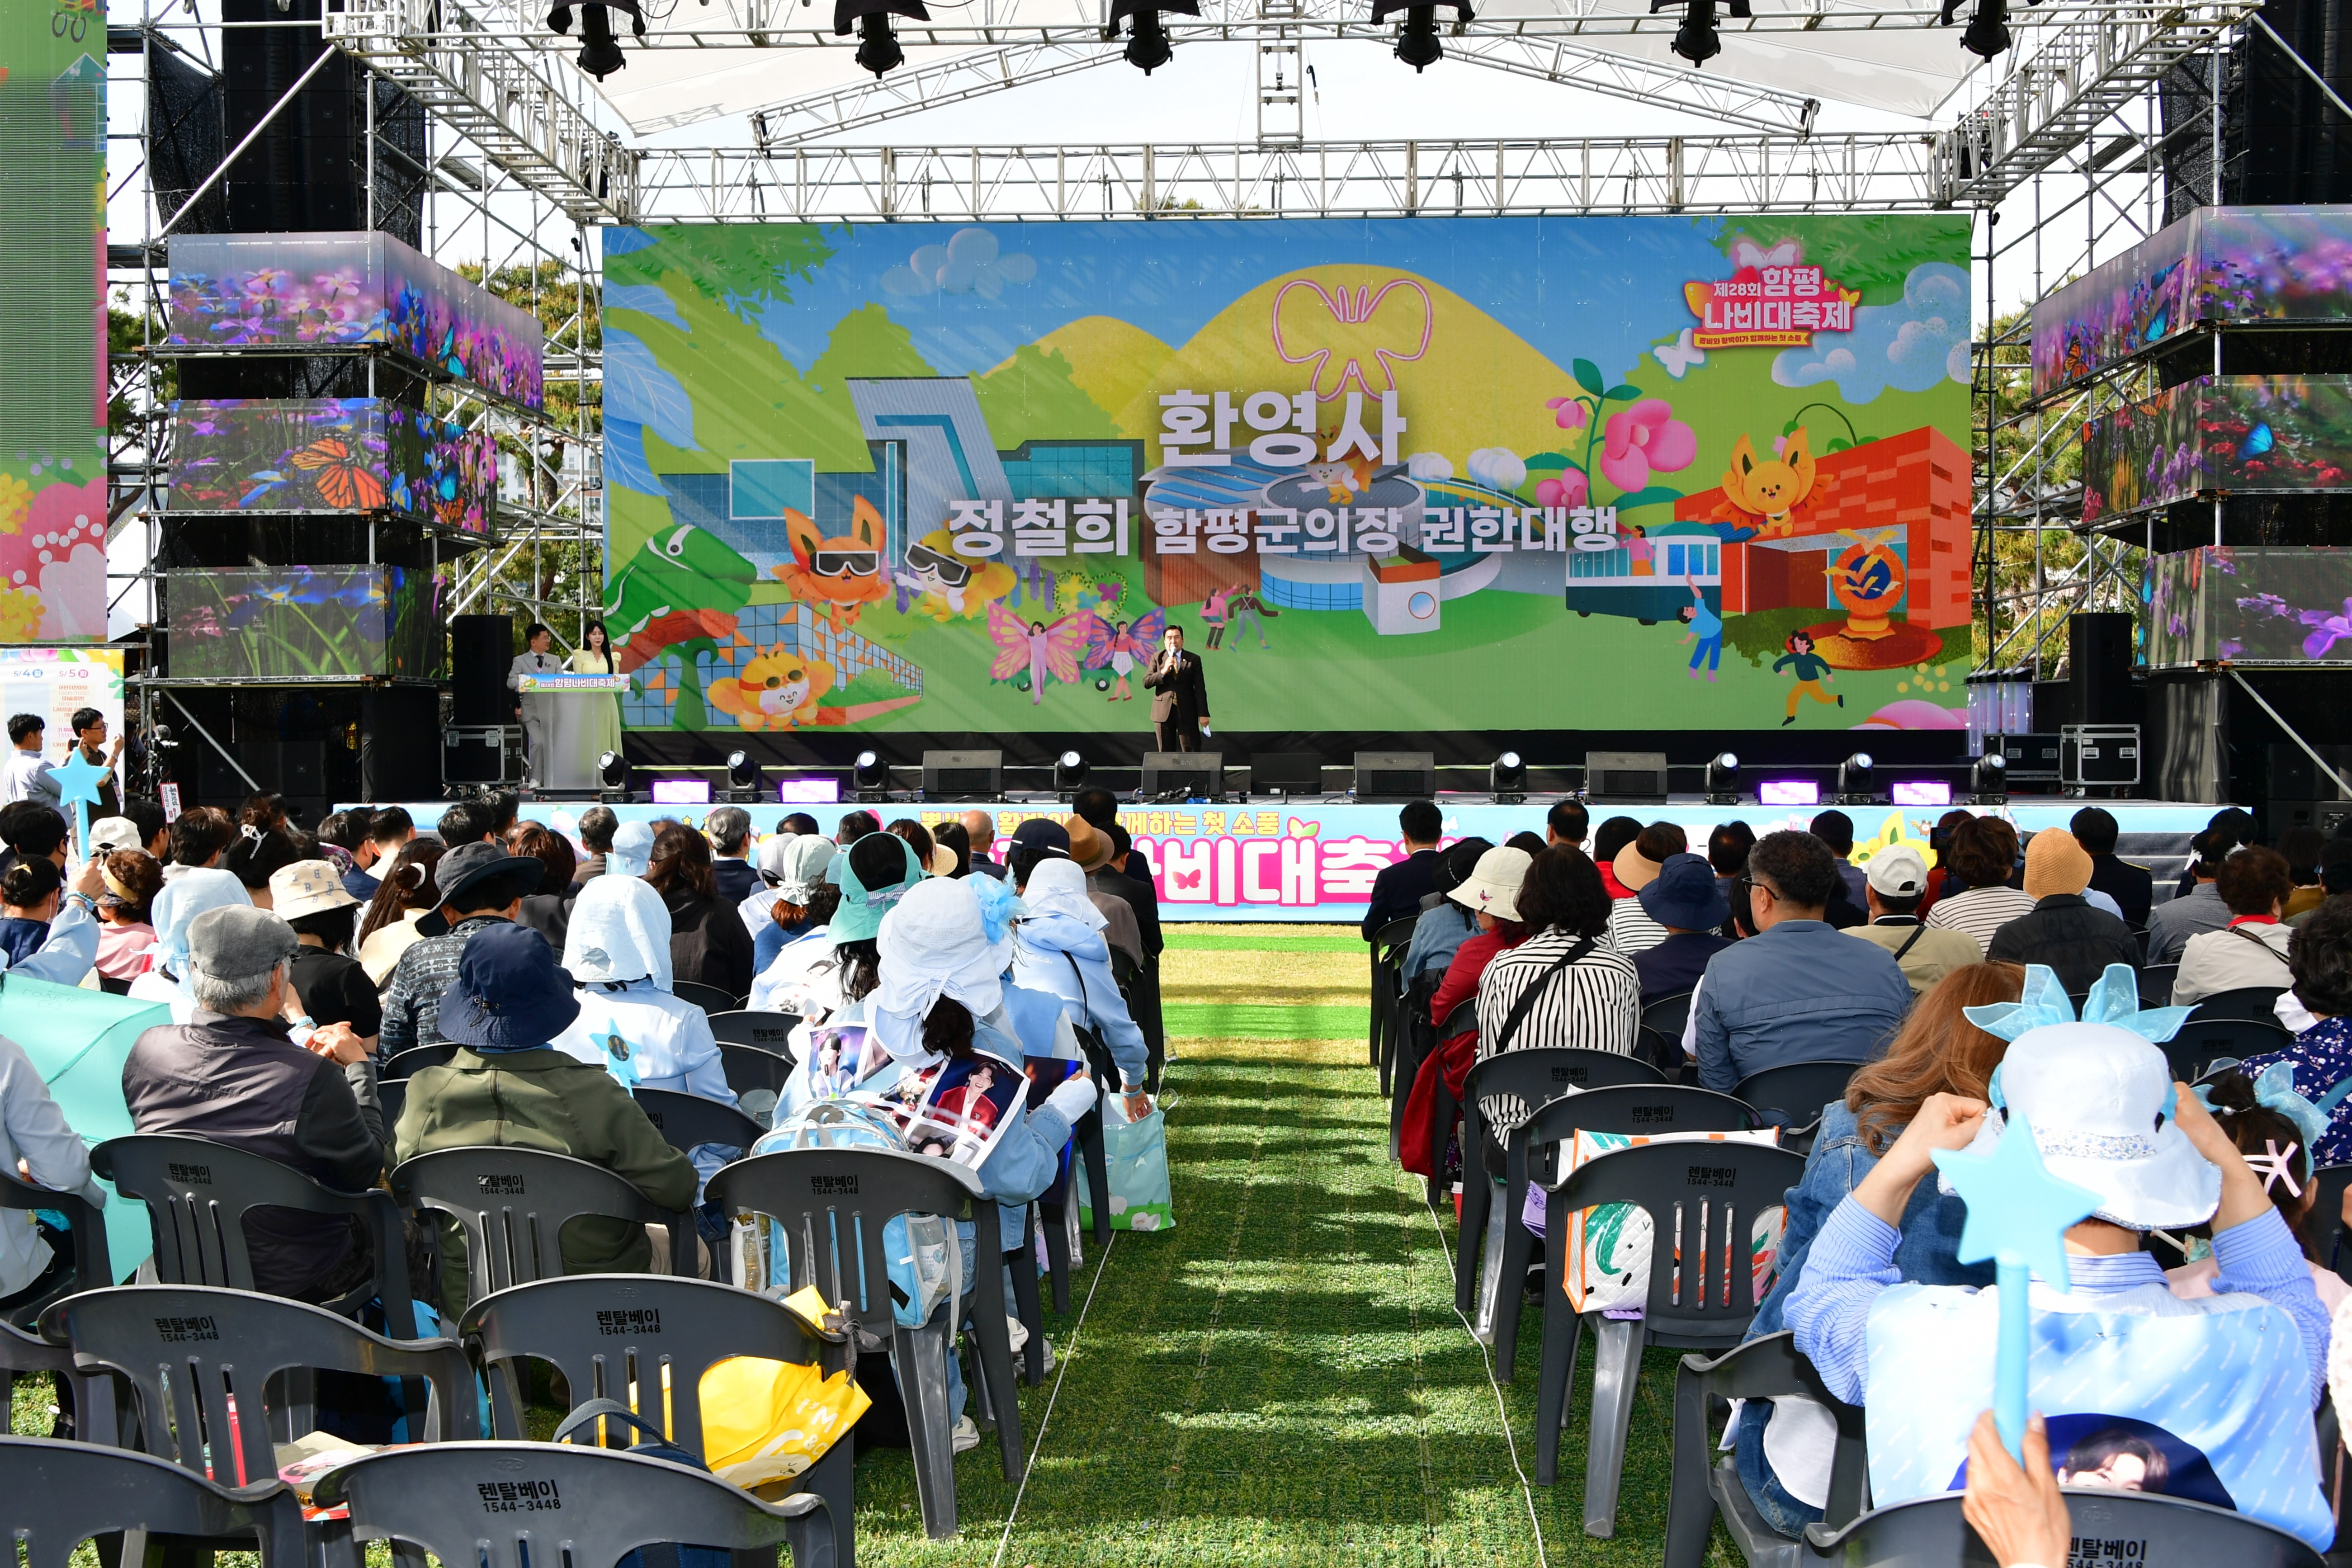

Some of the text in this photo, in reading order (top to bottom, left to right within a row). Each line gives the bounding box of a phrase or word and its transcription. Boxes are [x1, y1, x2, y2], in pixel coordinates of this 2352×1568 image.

[1714, 268, 1820, 297] 제28회 함평
[1705, 301, 1850, 330] 나비대축제
[1158, 389, 1407, 467] 환영사
[949, 498, 1616, 557] 정철희 함평군의장 권한대행
[555, 678, 615, 688] 함평나비대축제
[1202, 811, 1227, 835] 첫
[1231, 812, 1280, 835] 소풍
[1133, 835, 1465, 904] 비대축
[753, 1028, 784, 1037] 렌탈베이
[1551, 1067, 1587, 1077] 렌탈베이
[1632, 1105, 1673, 1117] 렌탈베이
[168, 1163, 211, 1178] 렌탈베이
[1688, 1166, 1737, 1180] 렌탈베이
[171, 1175, 212, 1185] 1544-3448
[811, 1175, 859, 1188] 렌탈베이
[1687, 1178, 1734, 1187] 1544-3448
[154, 1315, 217, 1332] 렌탈베이
[596, 1308, 660, 1326] 렌탈베이
[160, 1331, 219, 1342] 1544-3448
[599, 1324, 661, 1335] 1544-3448
[477, 1479, 559, 1501] 렌탈베이
[482, 1498, 561, 1513] 1544-3448
[2067, 1559, 2144, 1568] 544-3448
